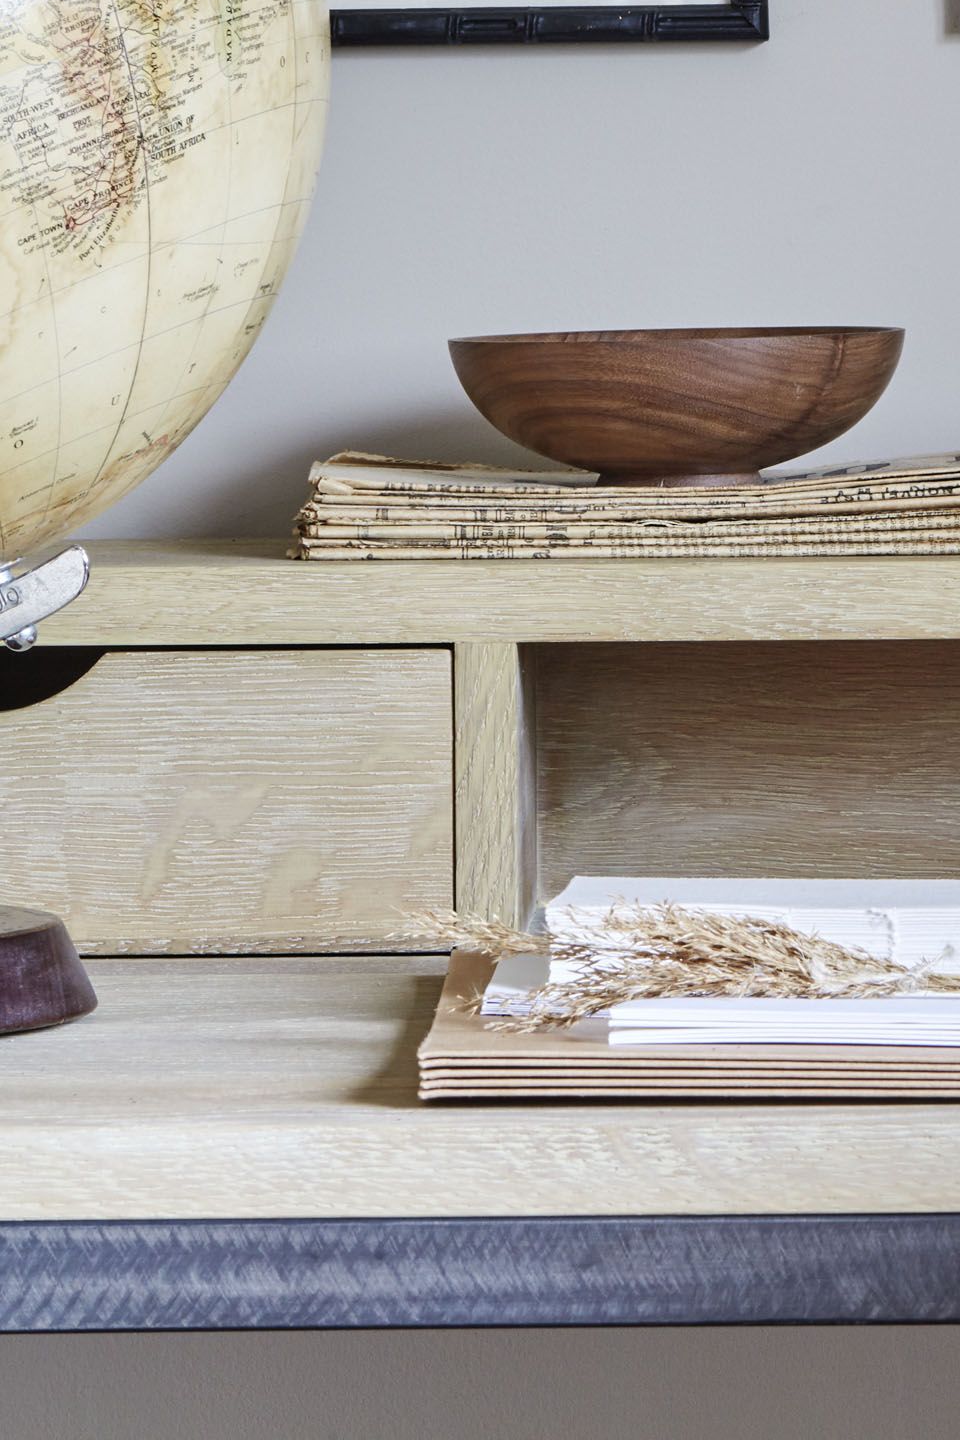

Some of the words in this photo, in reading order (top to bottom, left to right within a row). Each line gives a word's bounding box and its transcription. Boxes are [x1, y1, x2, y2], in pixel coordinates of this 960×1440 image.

[64, 14, 101, 33] RHODESIA
[3, 99, 54, 126] SOUTH-WEST
[15, 122, 50, 142] AFRICA
[160, 121, 183, 137] UNION
[186, 114, 195, 126] OF
[151, 146, 177, 161] SOUTH
[180, 132, 207, 151] AFRICA
[67, 196, 91, 212] CAPE
[18, 233, 37, 247] CAPE
[40, 222, 63, 238] TOWN
[79, 245, 95, 262] Port
[94, 208, 119, 246] Elizabeth
